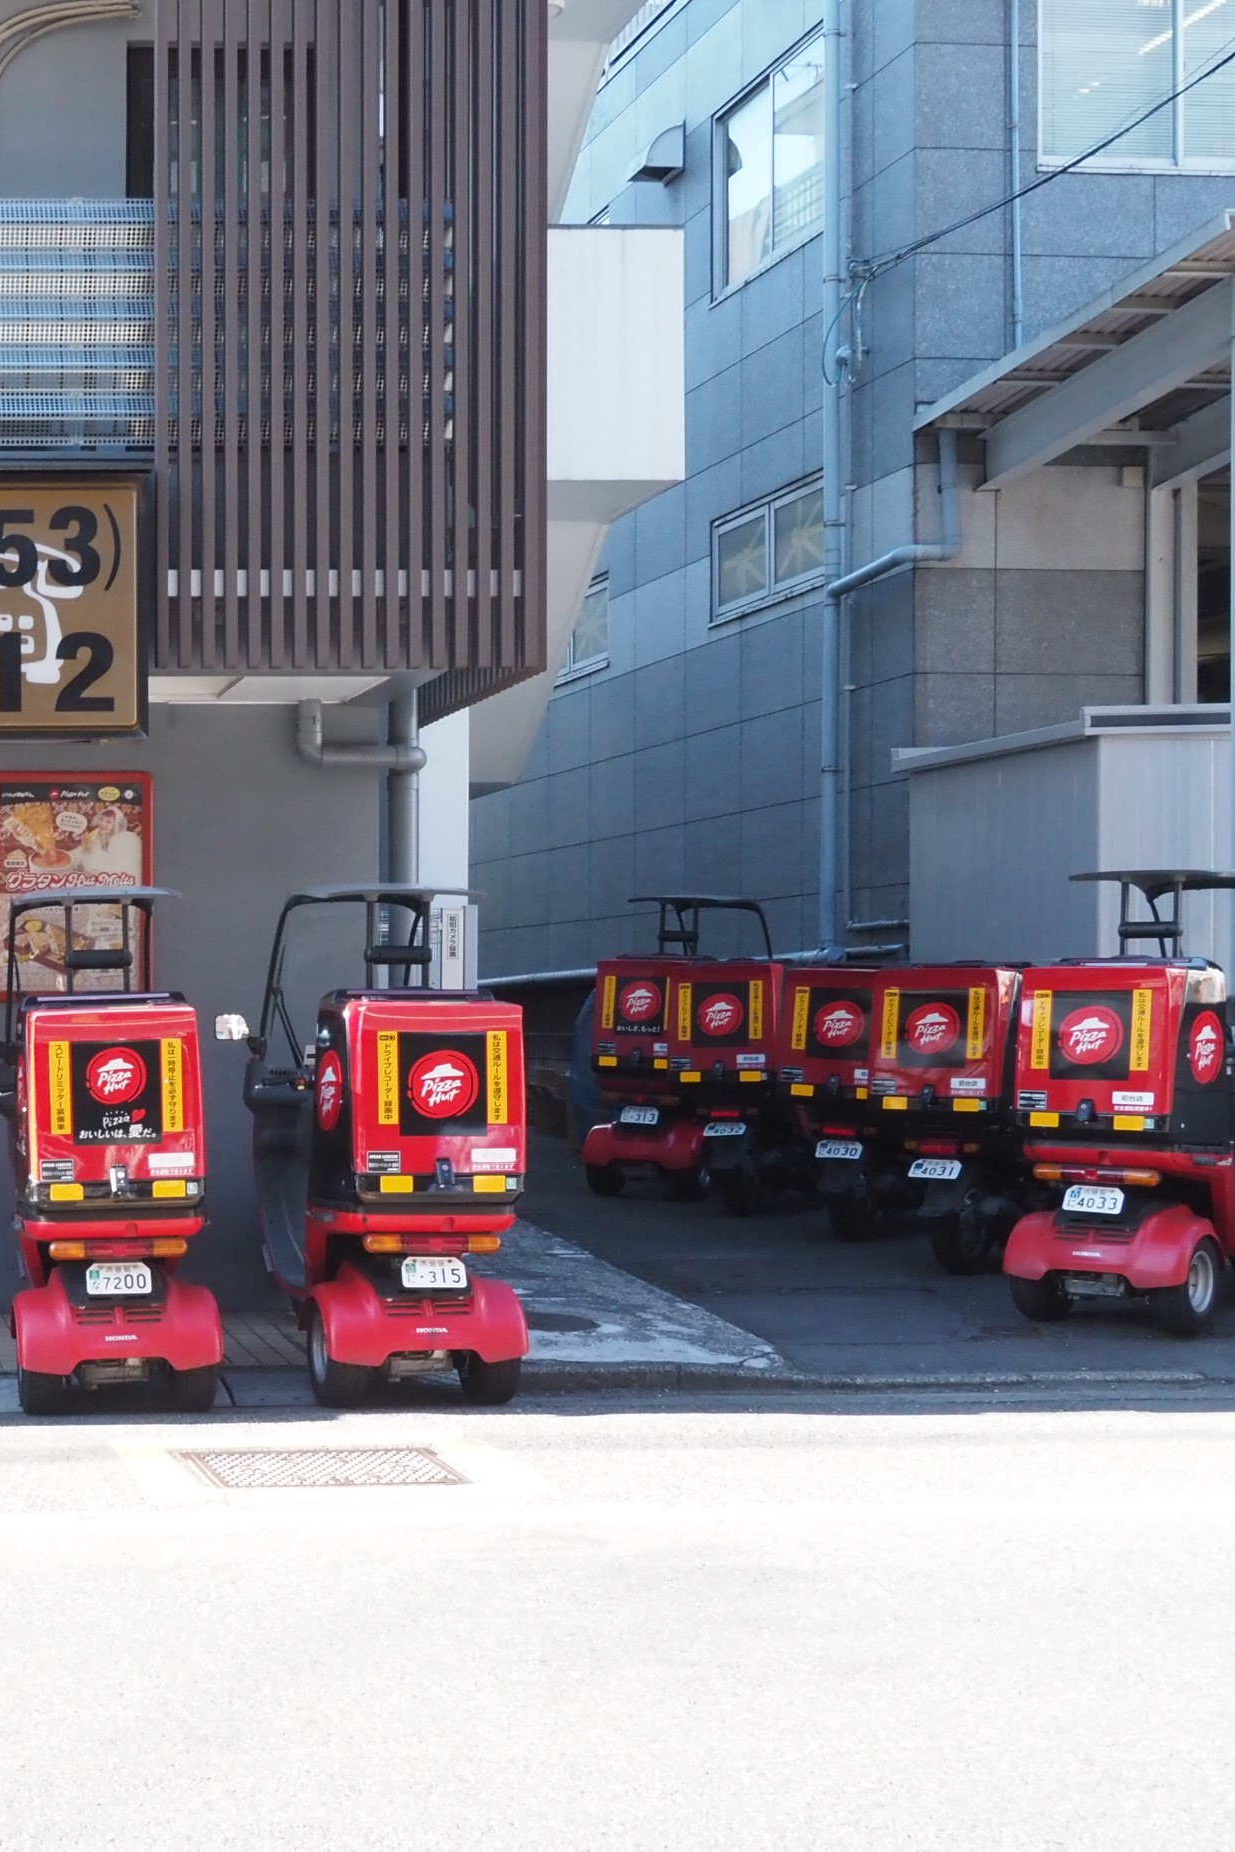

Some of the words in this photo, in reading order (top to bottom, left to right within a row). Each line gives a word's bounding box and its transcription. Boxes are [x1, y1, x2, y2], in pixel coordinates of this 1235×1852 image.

[822, 1019, 852, 1032] Pizza
[827, 1027, 850, 1038] Hut
[915, 1024, 946, 1038] Pizza
[920, 1032, 945, 1045] Hut
[1069, 1030, 1108, 1046] Pizza
[1075, 1039, 1105, 1055] Hut
[97, 1070, 132, 1087] Pizza
[103, 1080, 130, 1096] Hut
[421, 1078, 462, 1098] Pizza
[428, 1089, 461, 1107] Hut
[826, 1146, 858, 1157] 4030
[921, 1166, 954, 1177] 4031
[1077, 1196, 1118, 1210] 4033
[102, 1273, 147, 1290] 7200
[105, 1334, 138, 1342] HONDA
